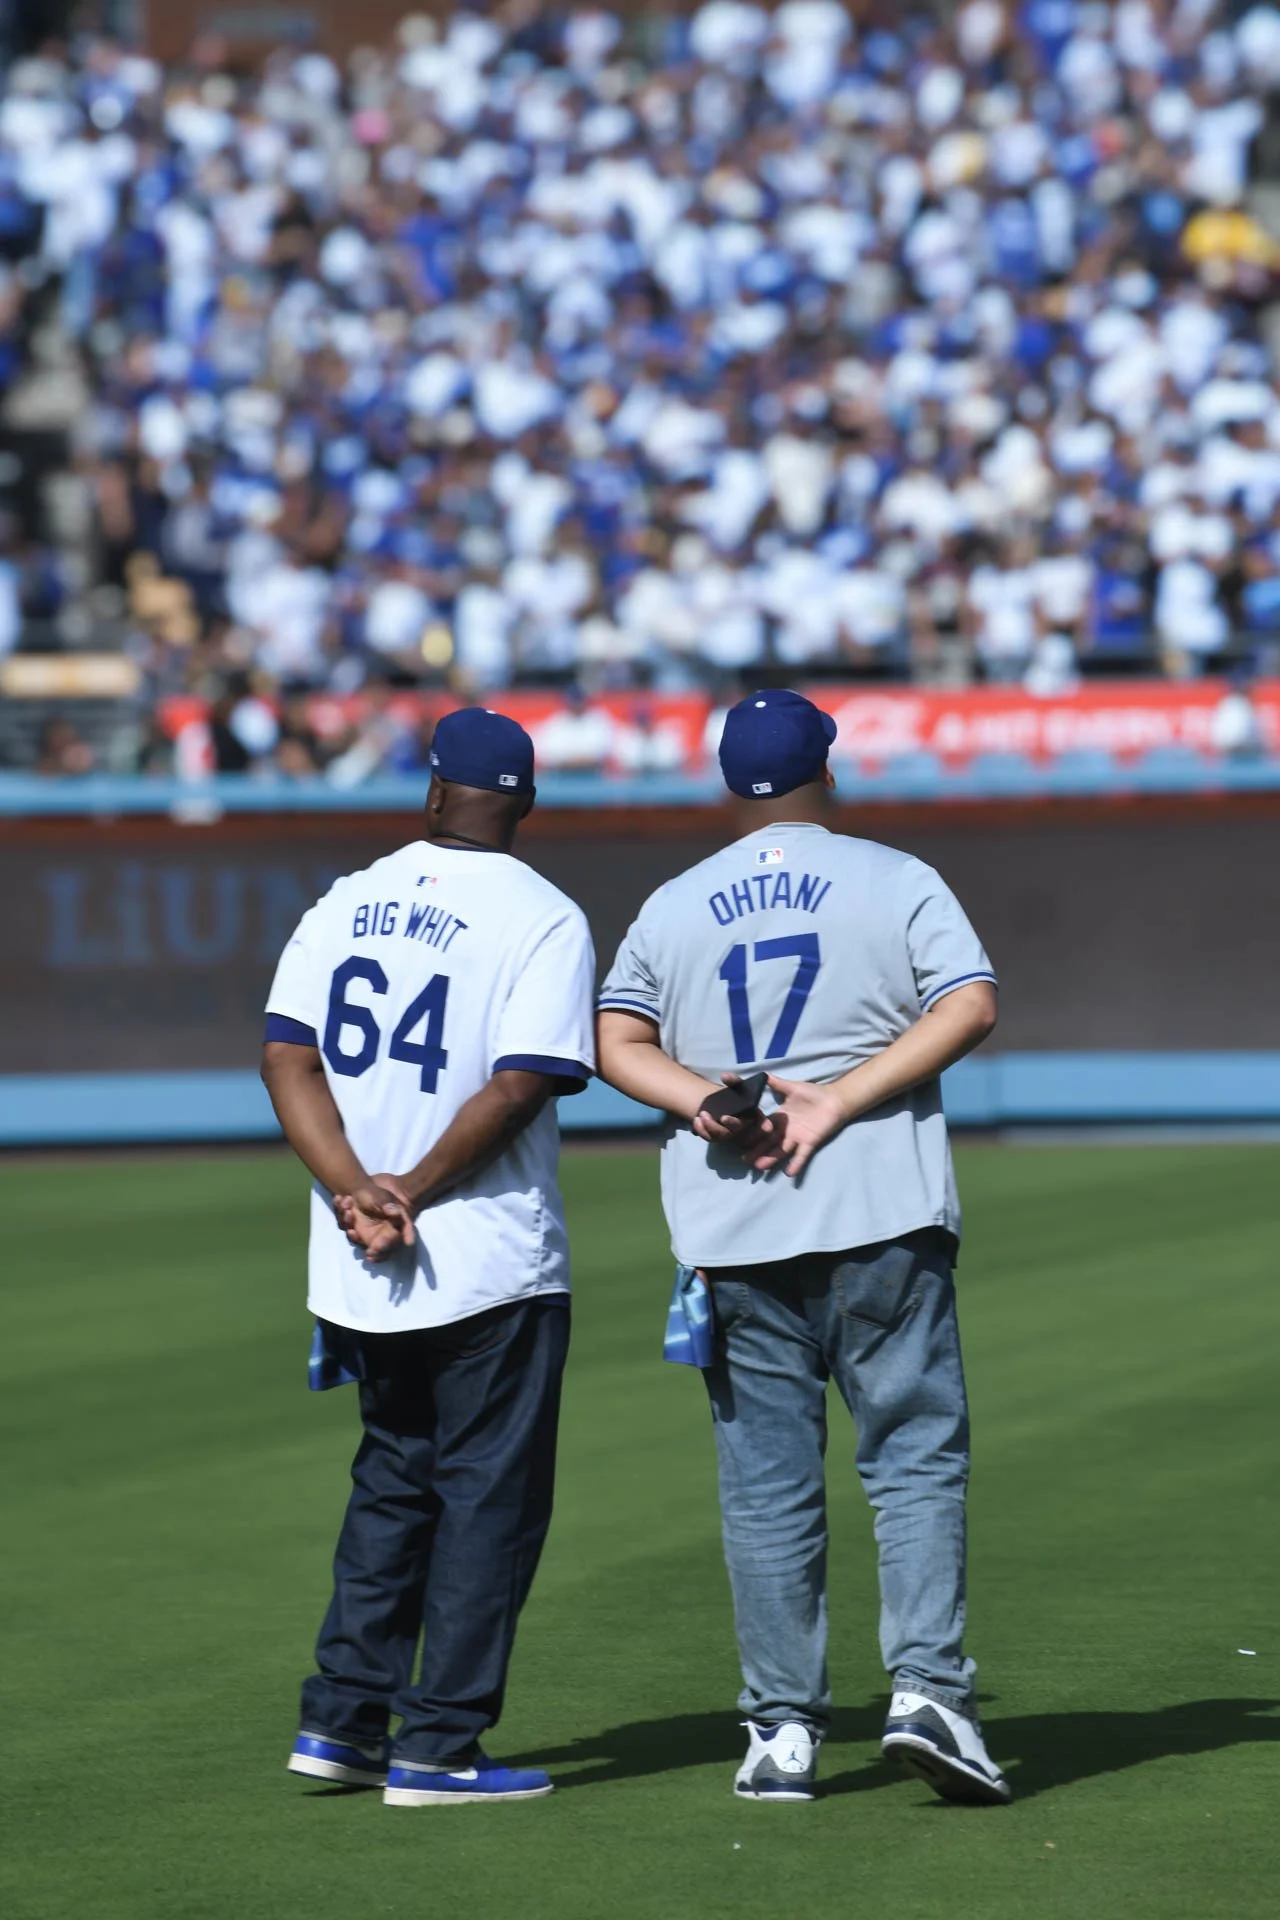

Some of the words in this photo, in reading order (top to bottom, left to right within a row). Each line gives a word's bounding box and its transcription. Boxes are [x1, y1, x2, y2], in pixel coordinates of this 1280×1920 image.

[353, 902, 400, 938] BIG
[404, 902, 469, 953] WHIT
[709, 872, 832, 926] OHTANI
[323, 955, 450, 1095] 64
[719, 932, 821, 1064] 17
